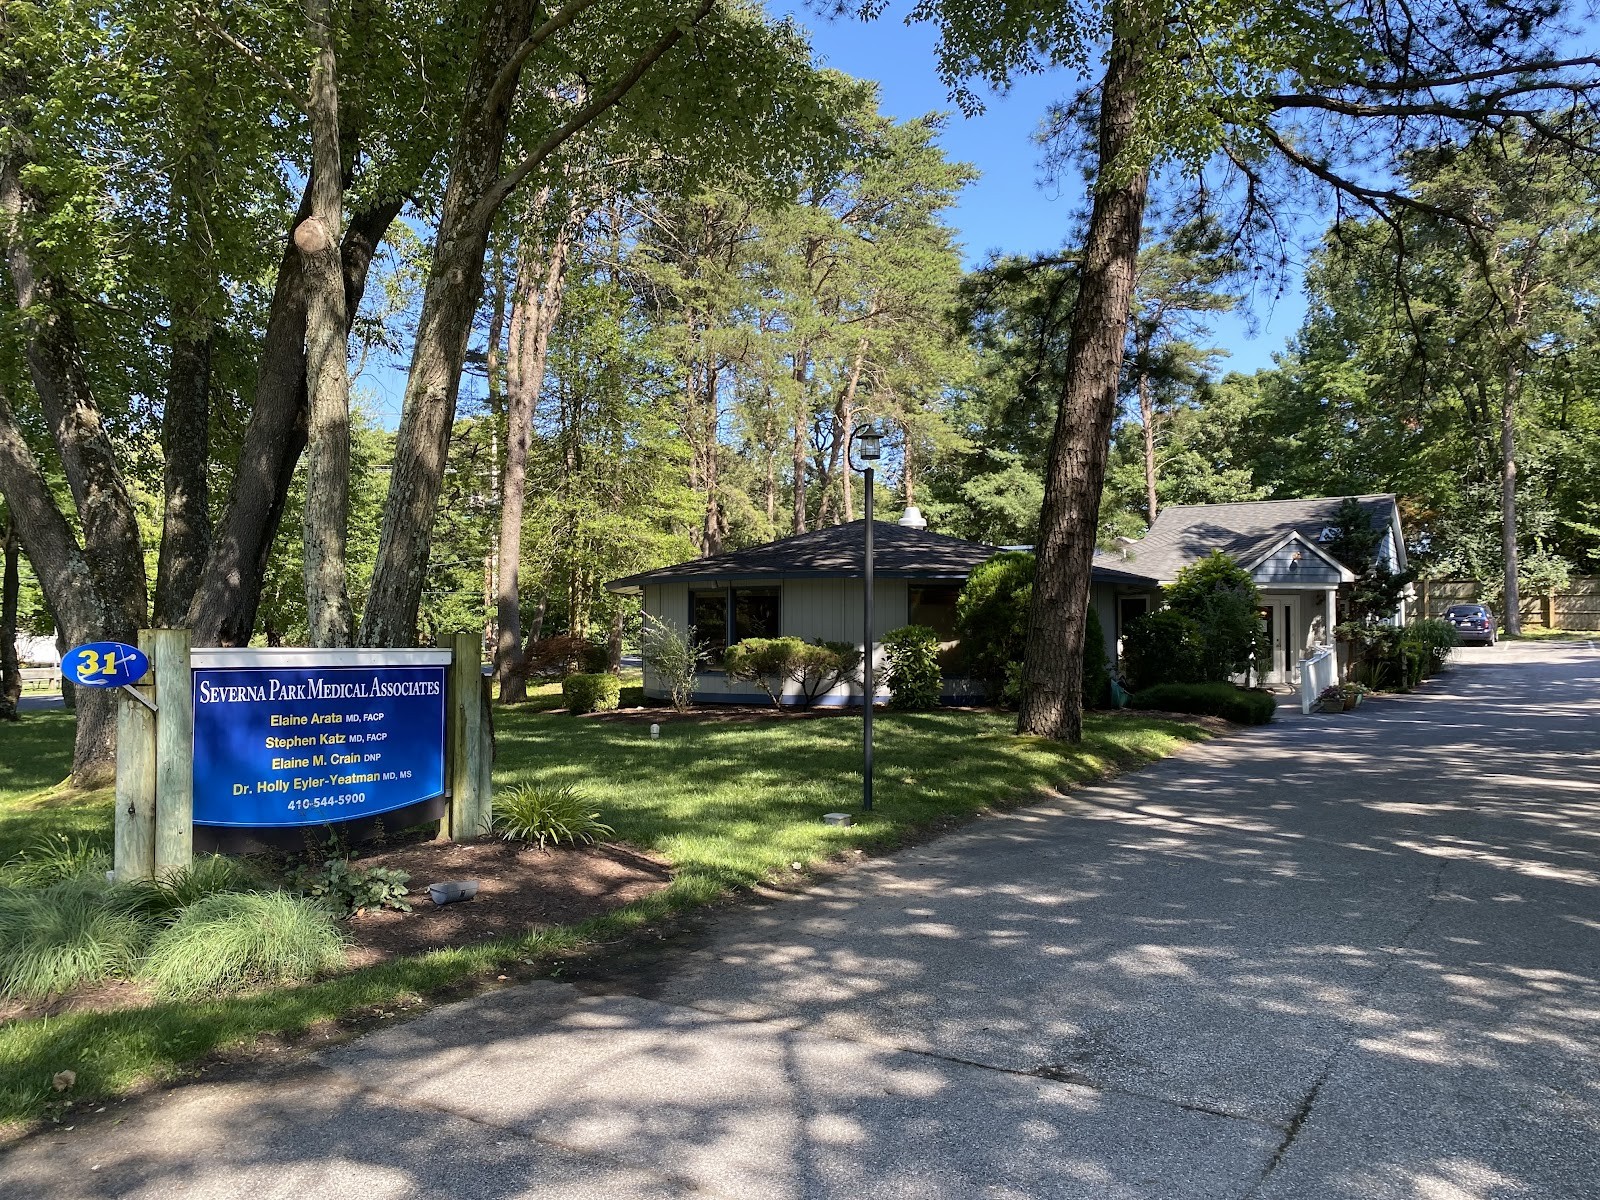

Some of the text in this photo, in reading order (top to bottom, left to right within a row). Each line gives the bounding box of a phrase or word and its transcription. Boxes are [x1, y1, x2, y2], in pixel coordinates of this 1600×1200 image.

[77, 650, 117, 675] 31
[200, 676, 440, 703] SEVERNA PARK MEDICAL ASSOCIATES
[270, 712, 385, 727] Elaine Arata MD, FACP
[265, 732, 388, 750] Stephen Katz MD, FACP
[271, 753, 382, 770] Elaine M. Crain DNP
[233, 770, 412, 796] Dr. Holly Eyler-Yeatman MD, MS
[287, 792, 366, 811] 410-544-5900
